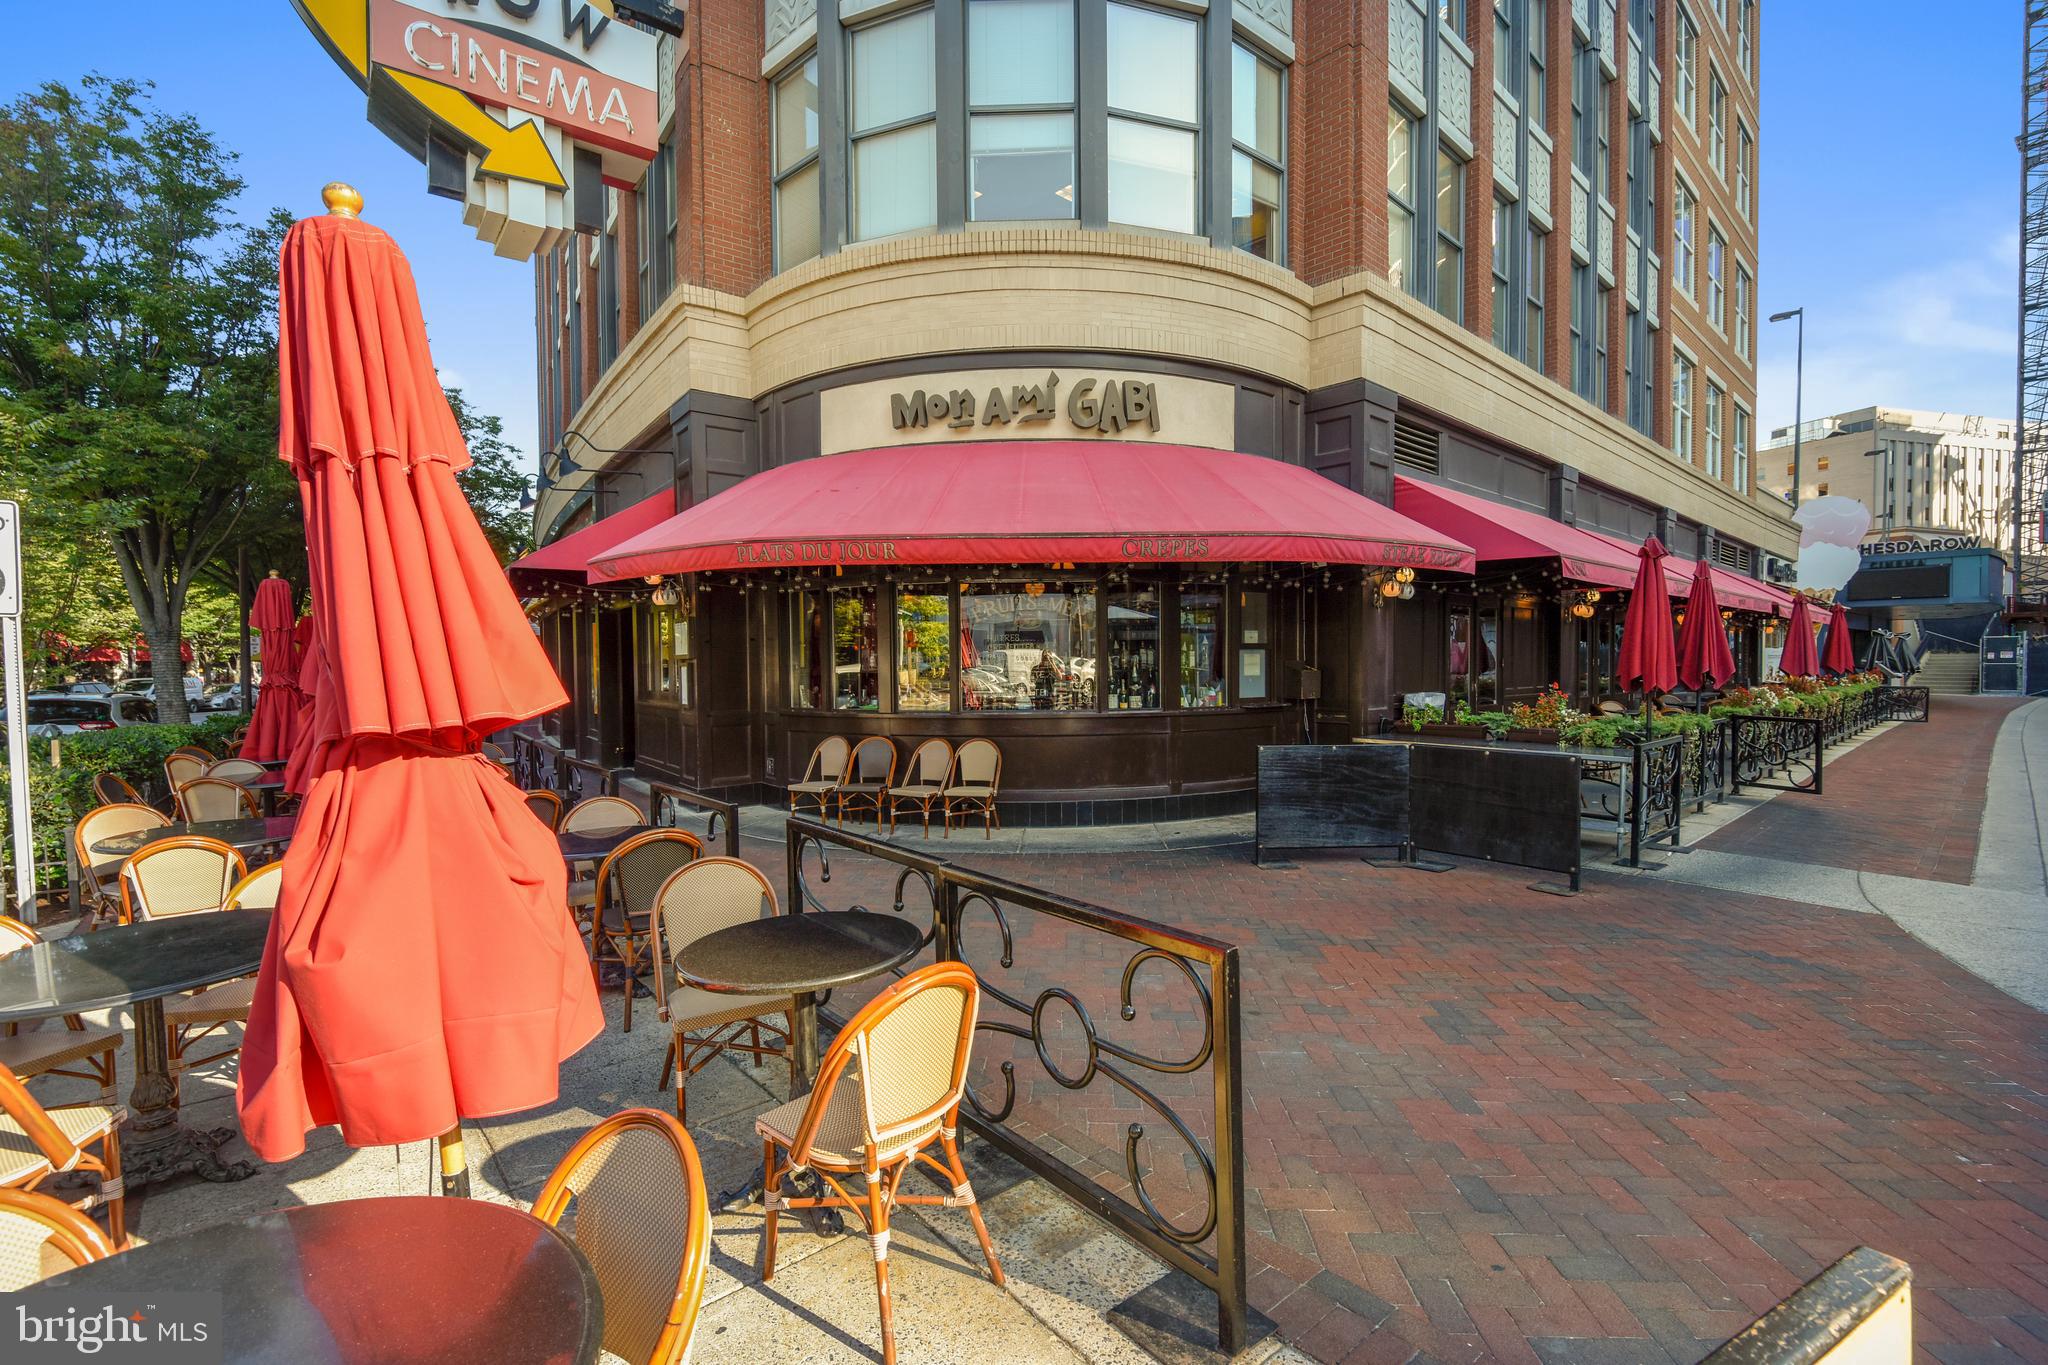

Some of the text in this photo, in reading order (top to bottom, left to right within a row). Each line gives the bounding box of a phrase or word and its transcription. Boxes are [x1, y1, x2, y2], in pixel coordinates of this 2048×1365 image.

[403, 20, 635, 135] CINEMA
[1067, 377, 1161, 434] GABI
[736, 541, 898, 563] PLATS DU JOUR
[1121, 538, 1209, 558] CREPES
[1383, 543, 1427, 564] STEAK
[1858, 535, 1981, 556] HESDA ROW
